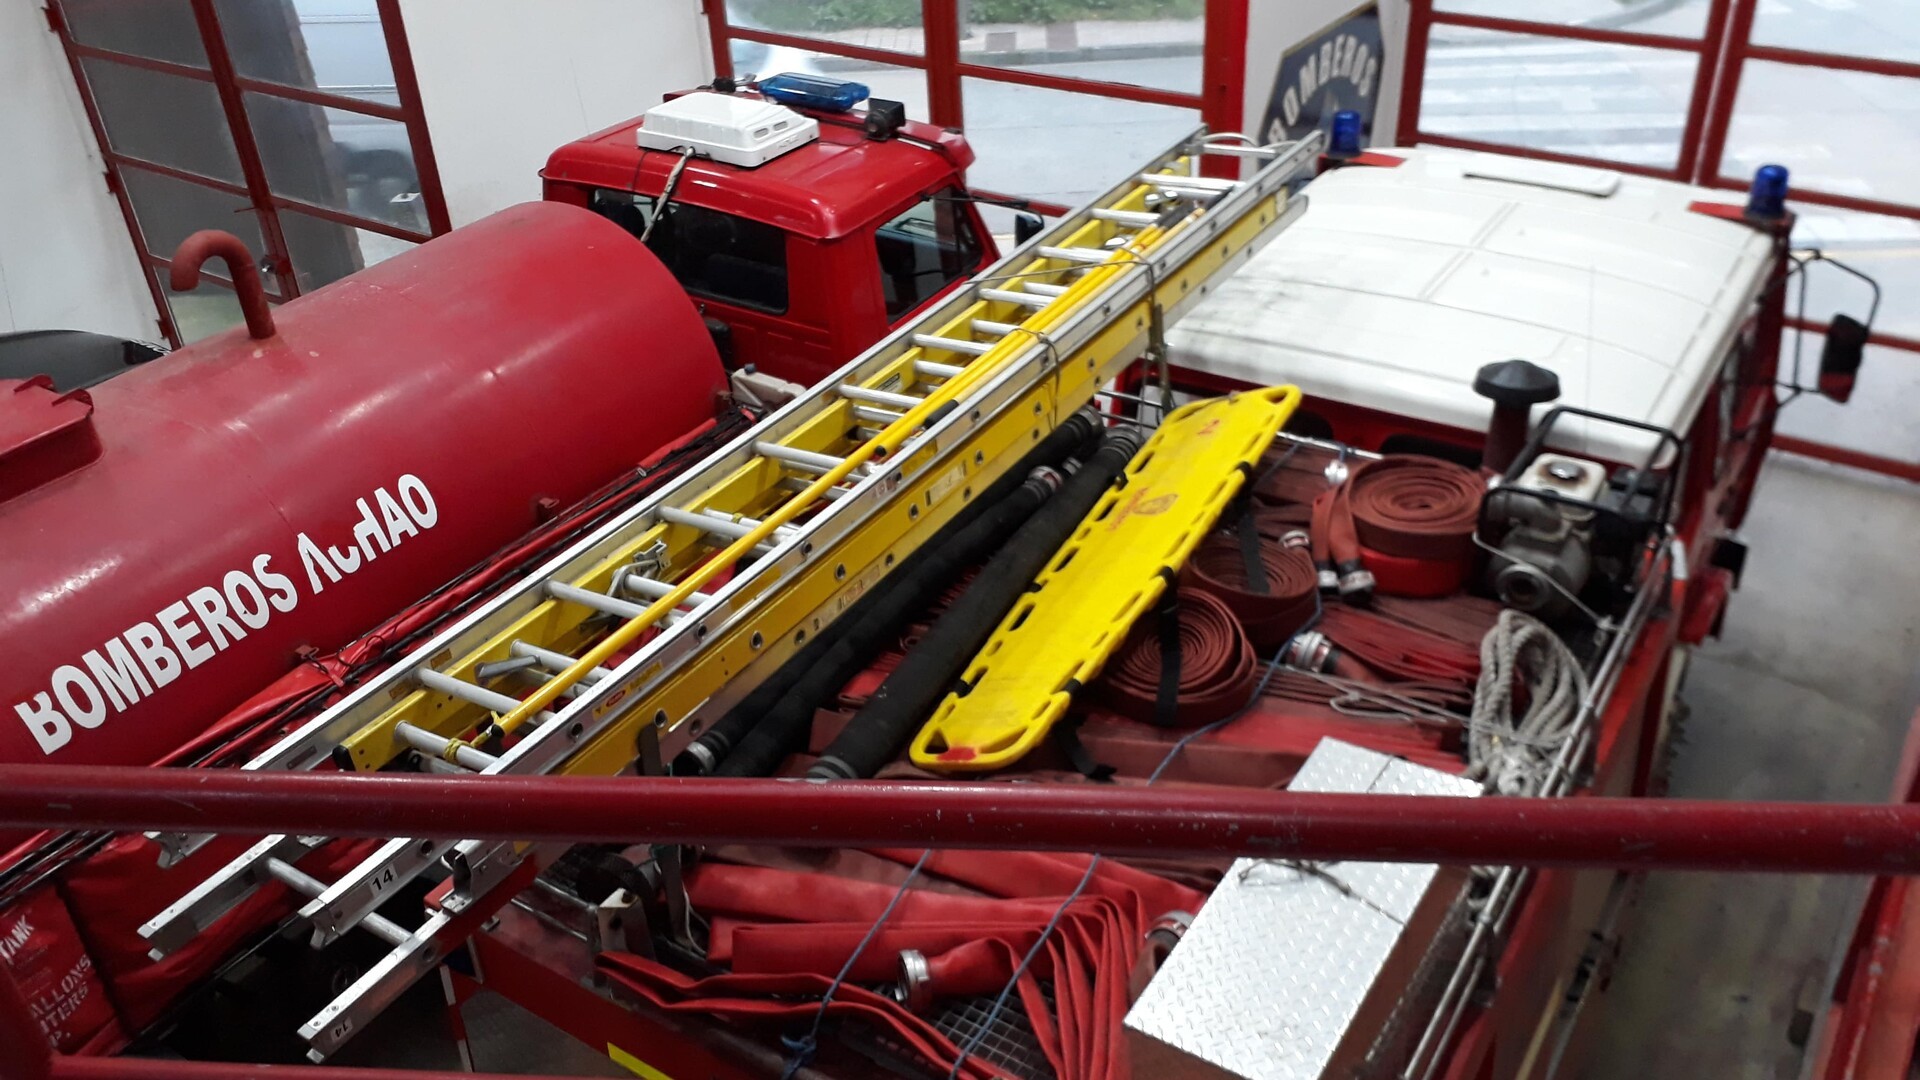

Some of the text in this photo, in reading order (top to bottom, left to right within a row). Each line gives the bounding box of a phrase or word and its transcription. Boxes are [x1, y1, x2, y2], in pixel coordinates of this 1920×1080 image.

[1267, 34, 1376, 144] BOMBEROS
[13, 553, 298, 756] BOMBEROS
[372, 868, 394, 891] 14
[0, 914, 35, 966] TANK
[30, 953, 92, 1018] ALLONS
